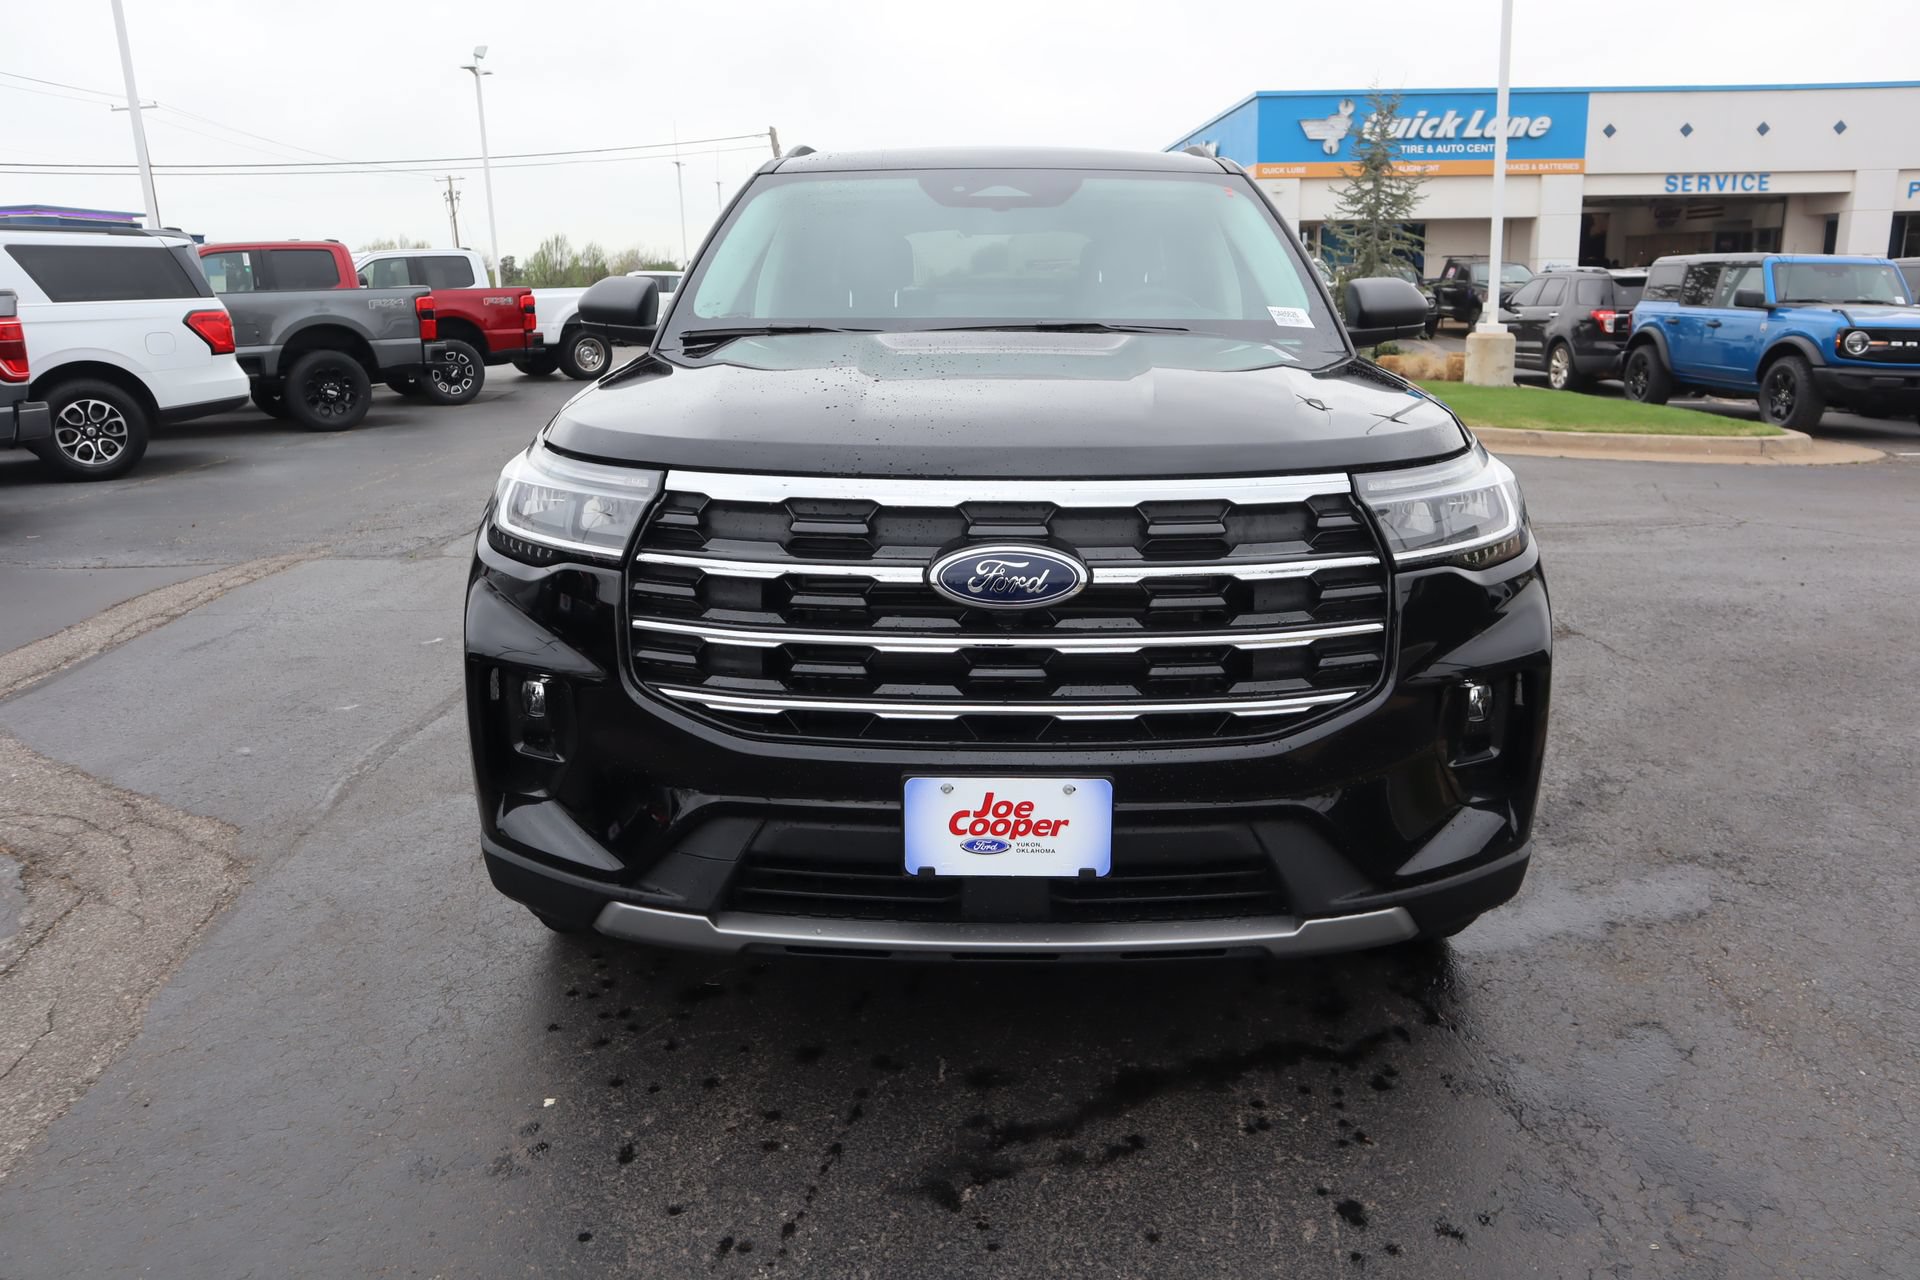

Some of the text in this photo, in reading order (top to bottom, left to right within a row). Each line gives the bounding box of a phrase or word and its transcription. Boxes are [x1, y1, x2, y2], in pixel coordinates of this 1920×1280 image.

[1400, 143, 1508, 154] TIRE & AUTO CENT
[1262, 166, 1306, 175] QUICK LUBE
[1538, 162, 1580, 171] BATTERIES
[1665, 173, 1771, 192] SERVICE
[967, 559, 1050, 594] Ford
[973, 792, 1034, 819] Joe
[948, 809, 1070, 840] Cooper
[973, 840, 999, 851] Ford
